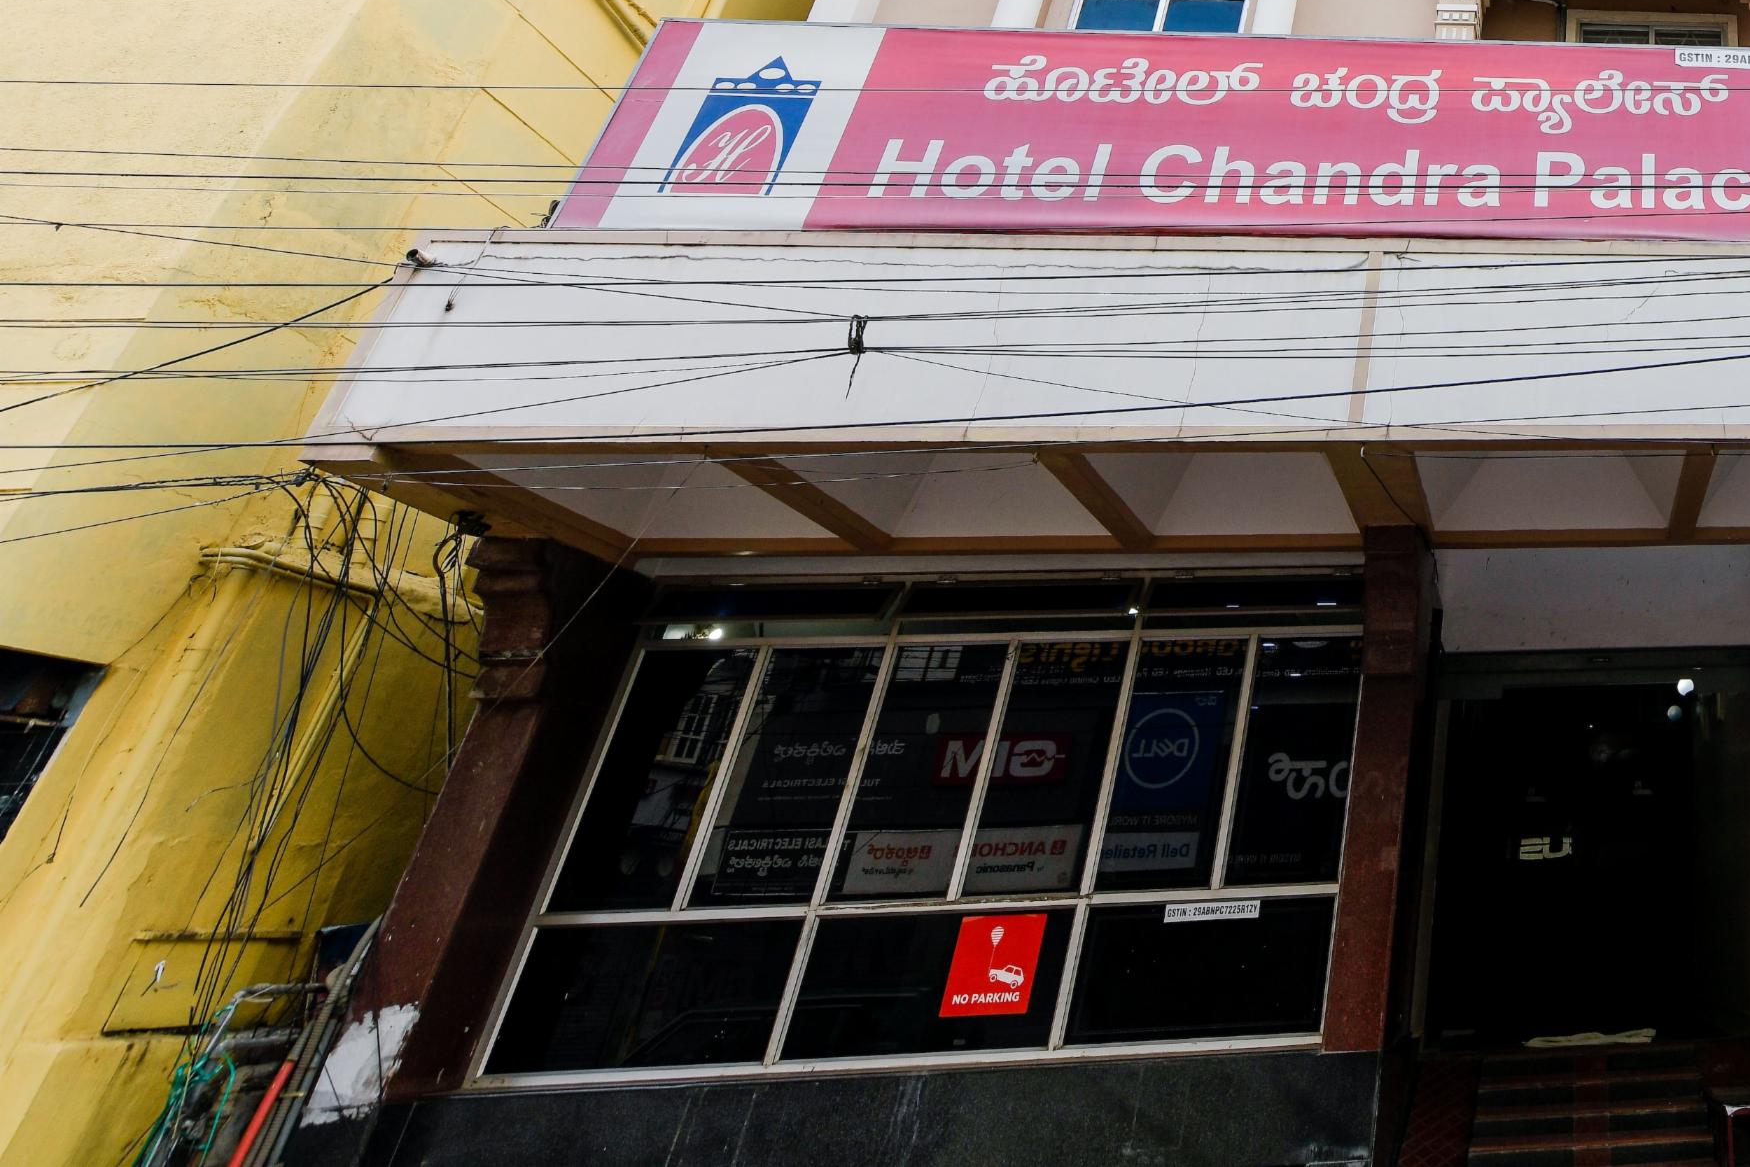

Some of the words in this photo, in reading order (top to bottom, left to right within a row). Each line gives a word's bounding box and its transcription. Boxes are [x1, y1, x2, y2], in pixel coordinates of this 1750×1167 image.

[1679, 52, 1713, 63] GSTIN
[1289, 66, 1443, 125] ಚಂದ್ರ
[1471, 68, 1729, 134] ಪ್ಯಾಲೇಸ್
[866, 138, 1113, 203] Hotel
[1138, 142, 1503, 209] Chandra
[1167, 907, 1187, 917] GSTIN
[952, 993, 969, 1005] NO
[970, 991, 1020, 1005] PARKING
